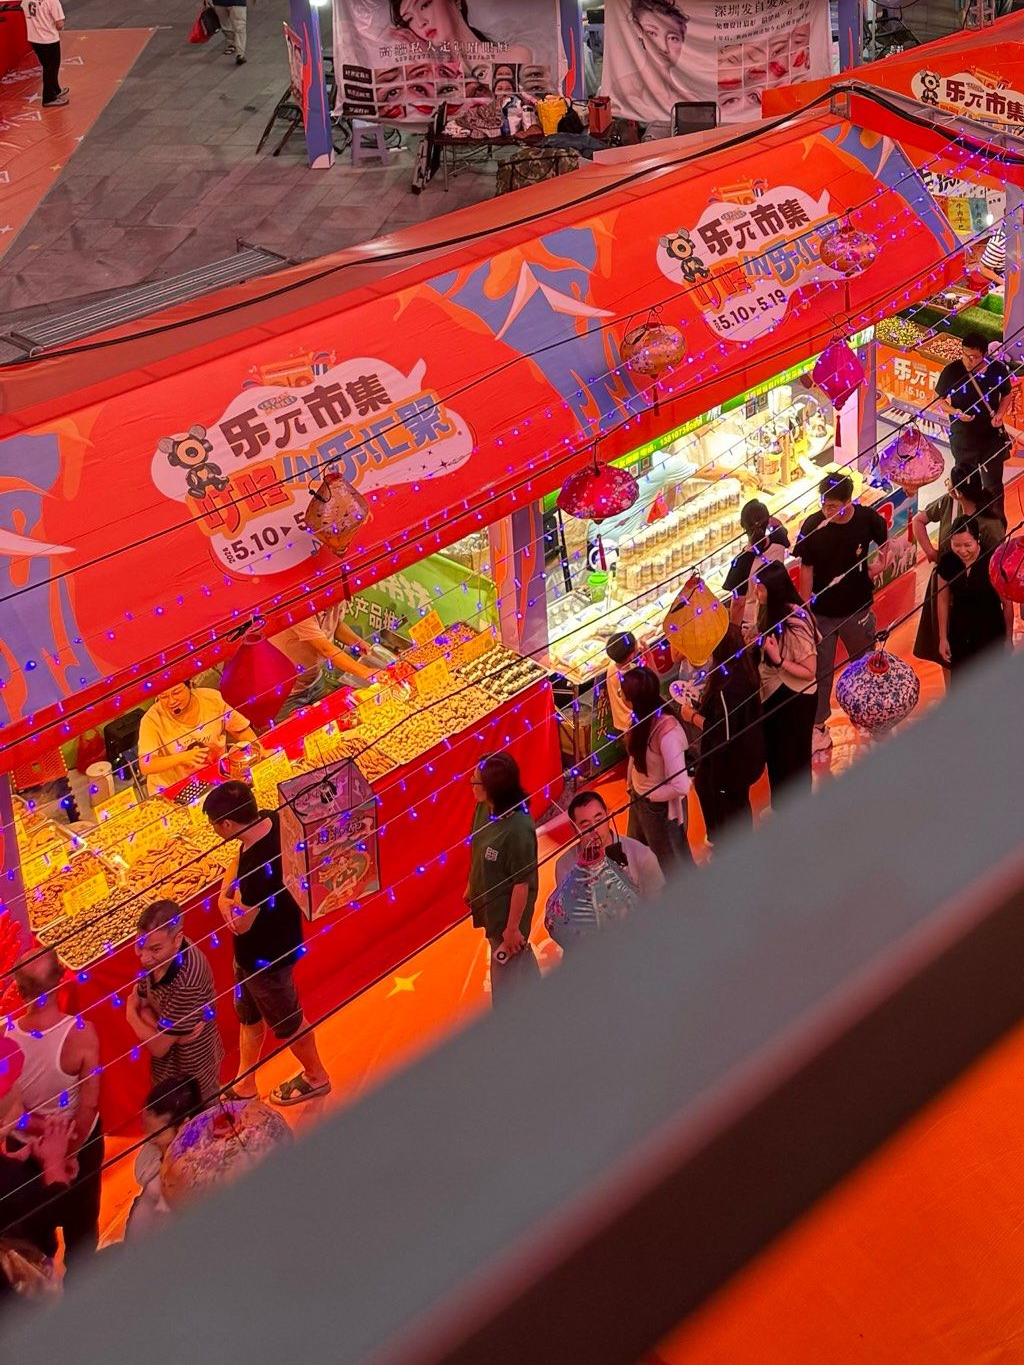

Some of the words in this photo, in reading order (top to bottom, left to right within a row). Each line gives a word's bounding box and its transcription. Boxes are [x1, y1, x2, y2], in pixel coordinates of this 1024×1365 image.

[757, 288, 787, 311] 5.19
[718, 306, 750, 330] 5.10
[231, 526, 279, 560] 5.10
